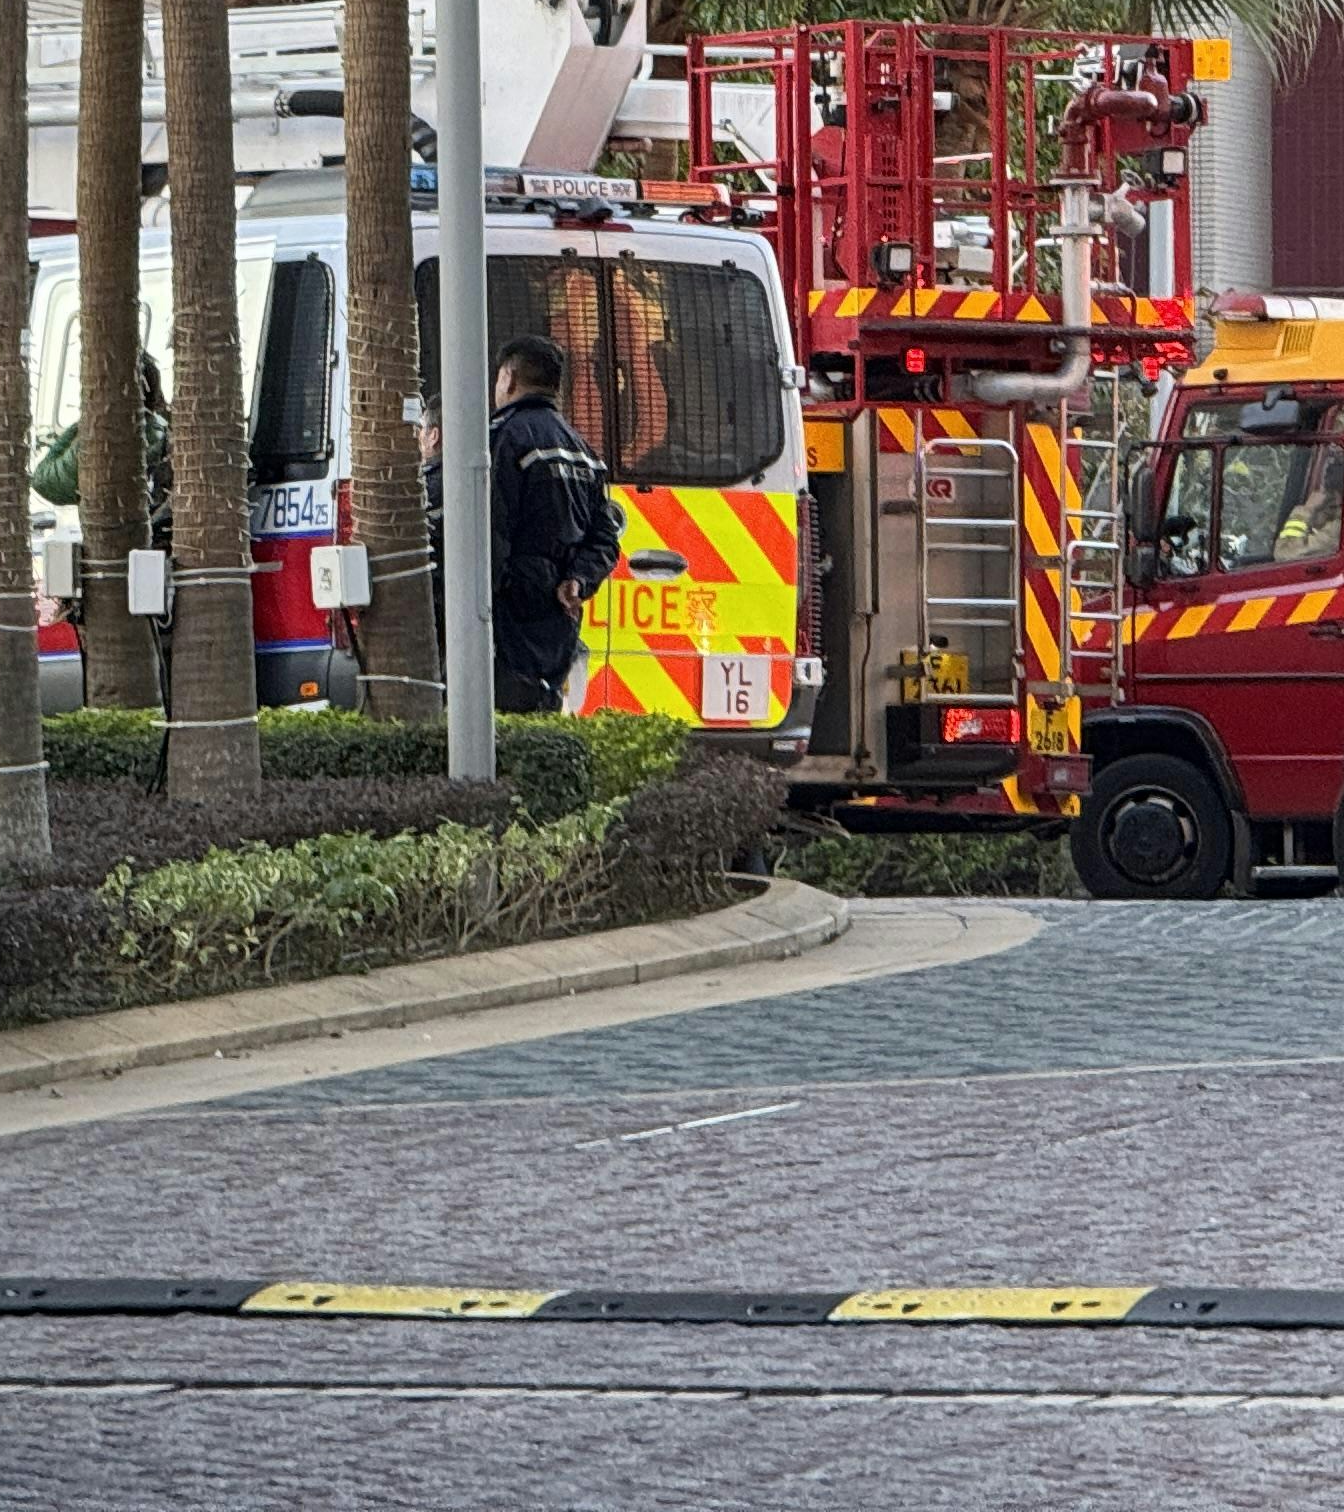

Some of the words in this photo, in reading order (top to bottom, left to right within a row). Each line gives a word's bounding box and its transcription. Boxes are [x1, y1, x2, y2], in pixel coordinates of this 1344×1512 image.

[553, 179, 608, 196] POLICE
[260, 485, 314, 528] 7854
[588, 585, 681, 629] LICE
[720, 661, 753, 687] YL
[727, 690, 749, 714] 16
